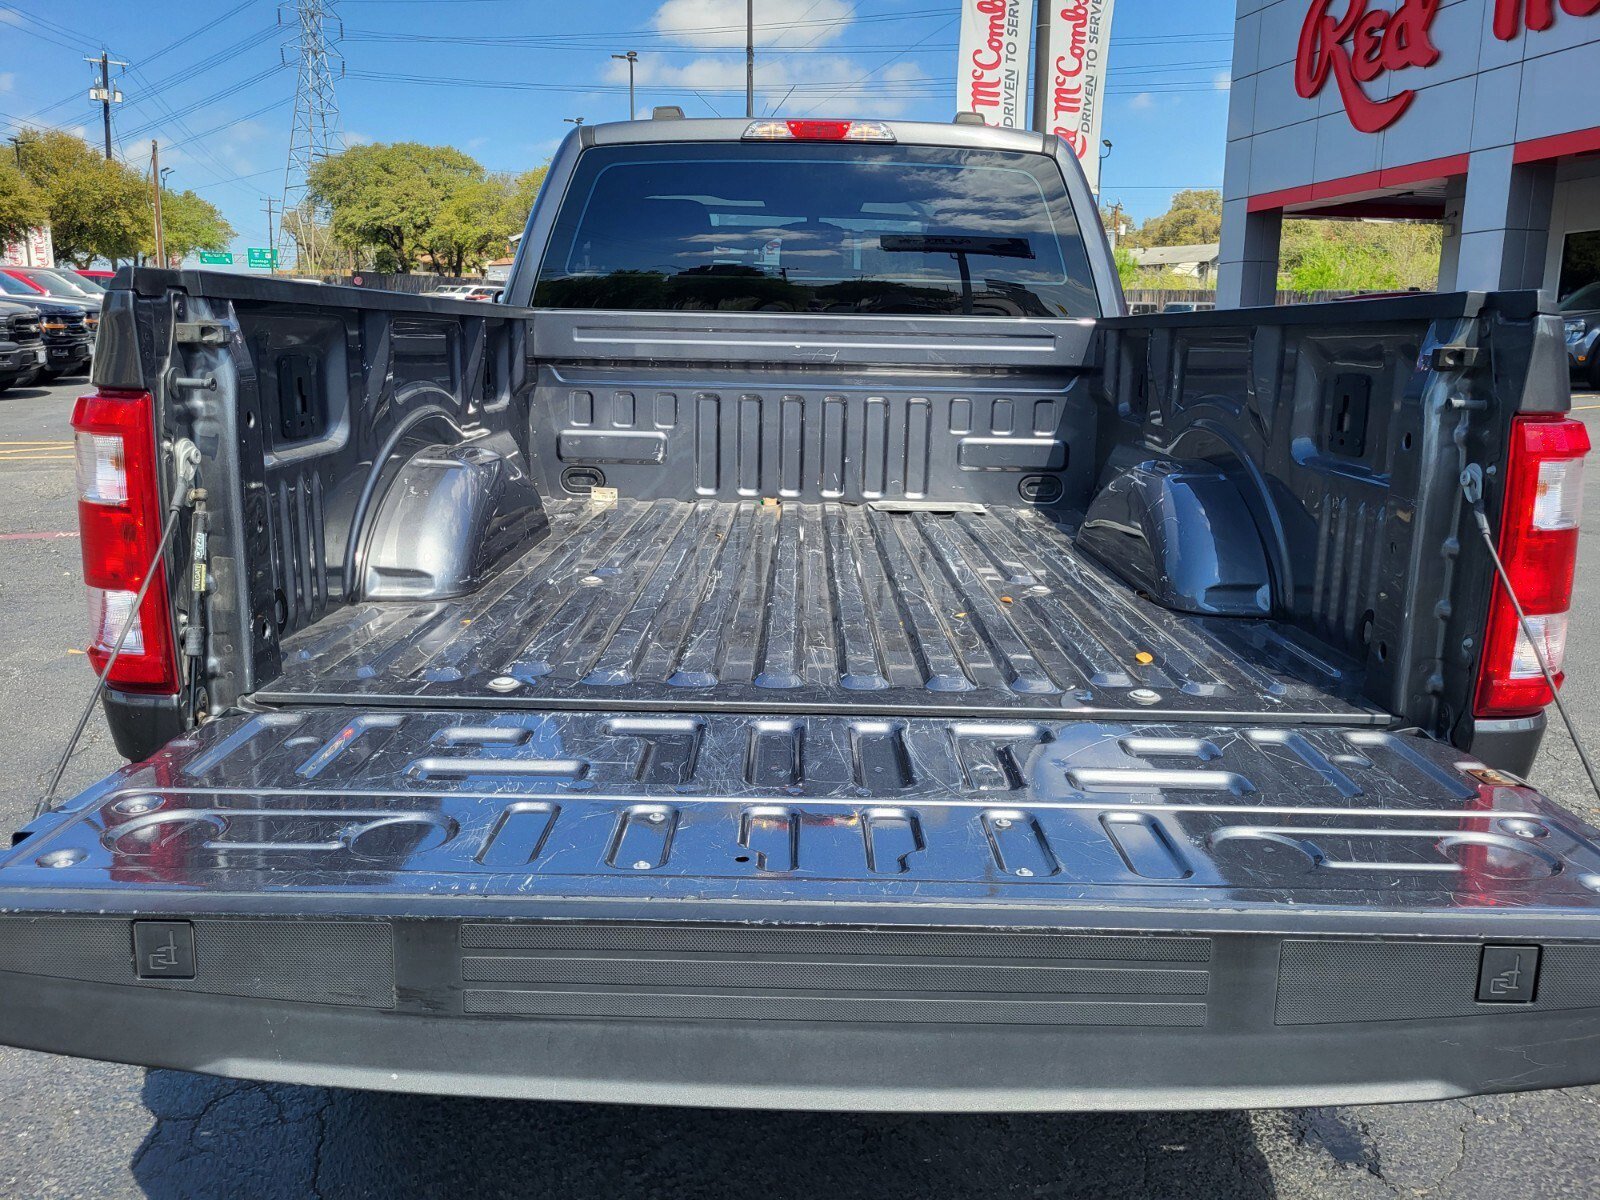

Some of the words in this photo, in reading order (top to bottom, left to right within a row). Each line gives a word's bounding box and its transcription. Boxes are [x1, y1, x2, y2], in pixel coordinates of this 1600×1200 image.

[1005, 42, 1017, 63] TO
[1086, 49, 1097, 70] TO
[1294, 0, 1440, 133] Red
[1003, 68, 1016, 128] DRIVEN
[1081, 75, 1095, 133] DRIVEN
